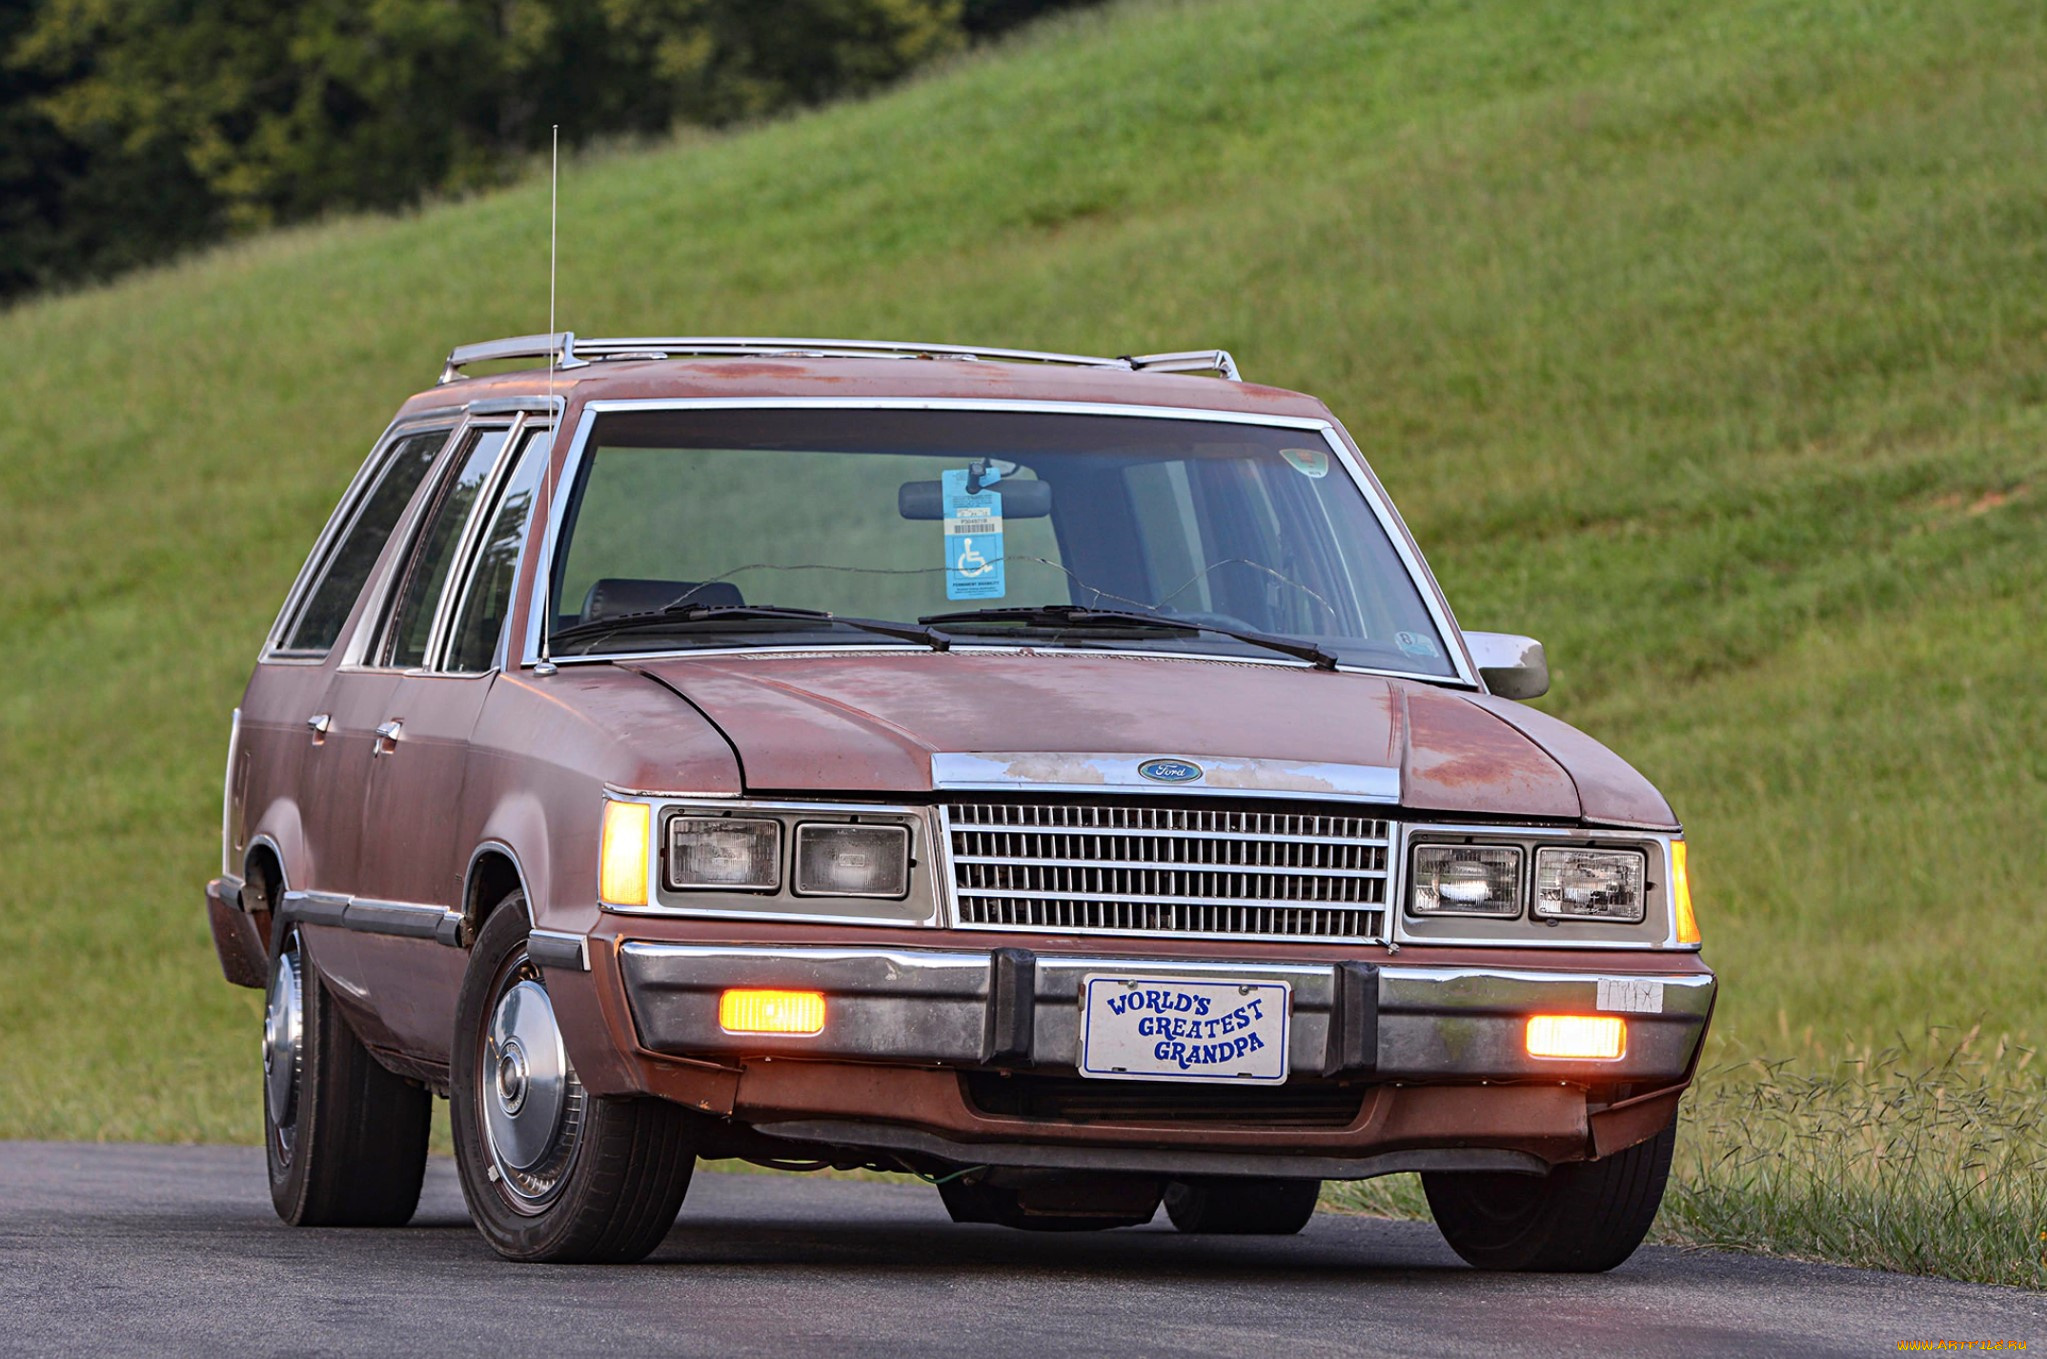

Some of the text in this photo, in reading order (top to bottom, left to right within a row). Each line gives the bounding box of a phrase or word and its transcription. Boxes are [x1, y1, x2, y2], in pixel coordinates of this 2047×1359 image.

[1155, 764, 1186, 776] Ford
[1107, 990, 1211, 1016] WORLD'S
[1138, 998, 1264, 1041] GREATEST
[1154, 1031, 1265, 1070] GRANDPA
